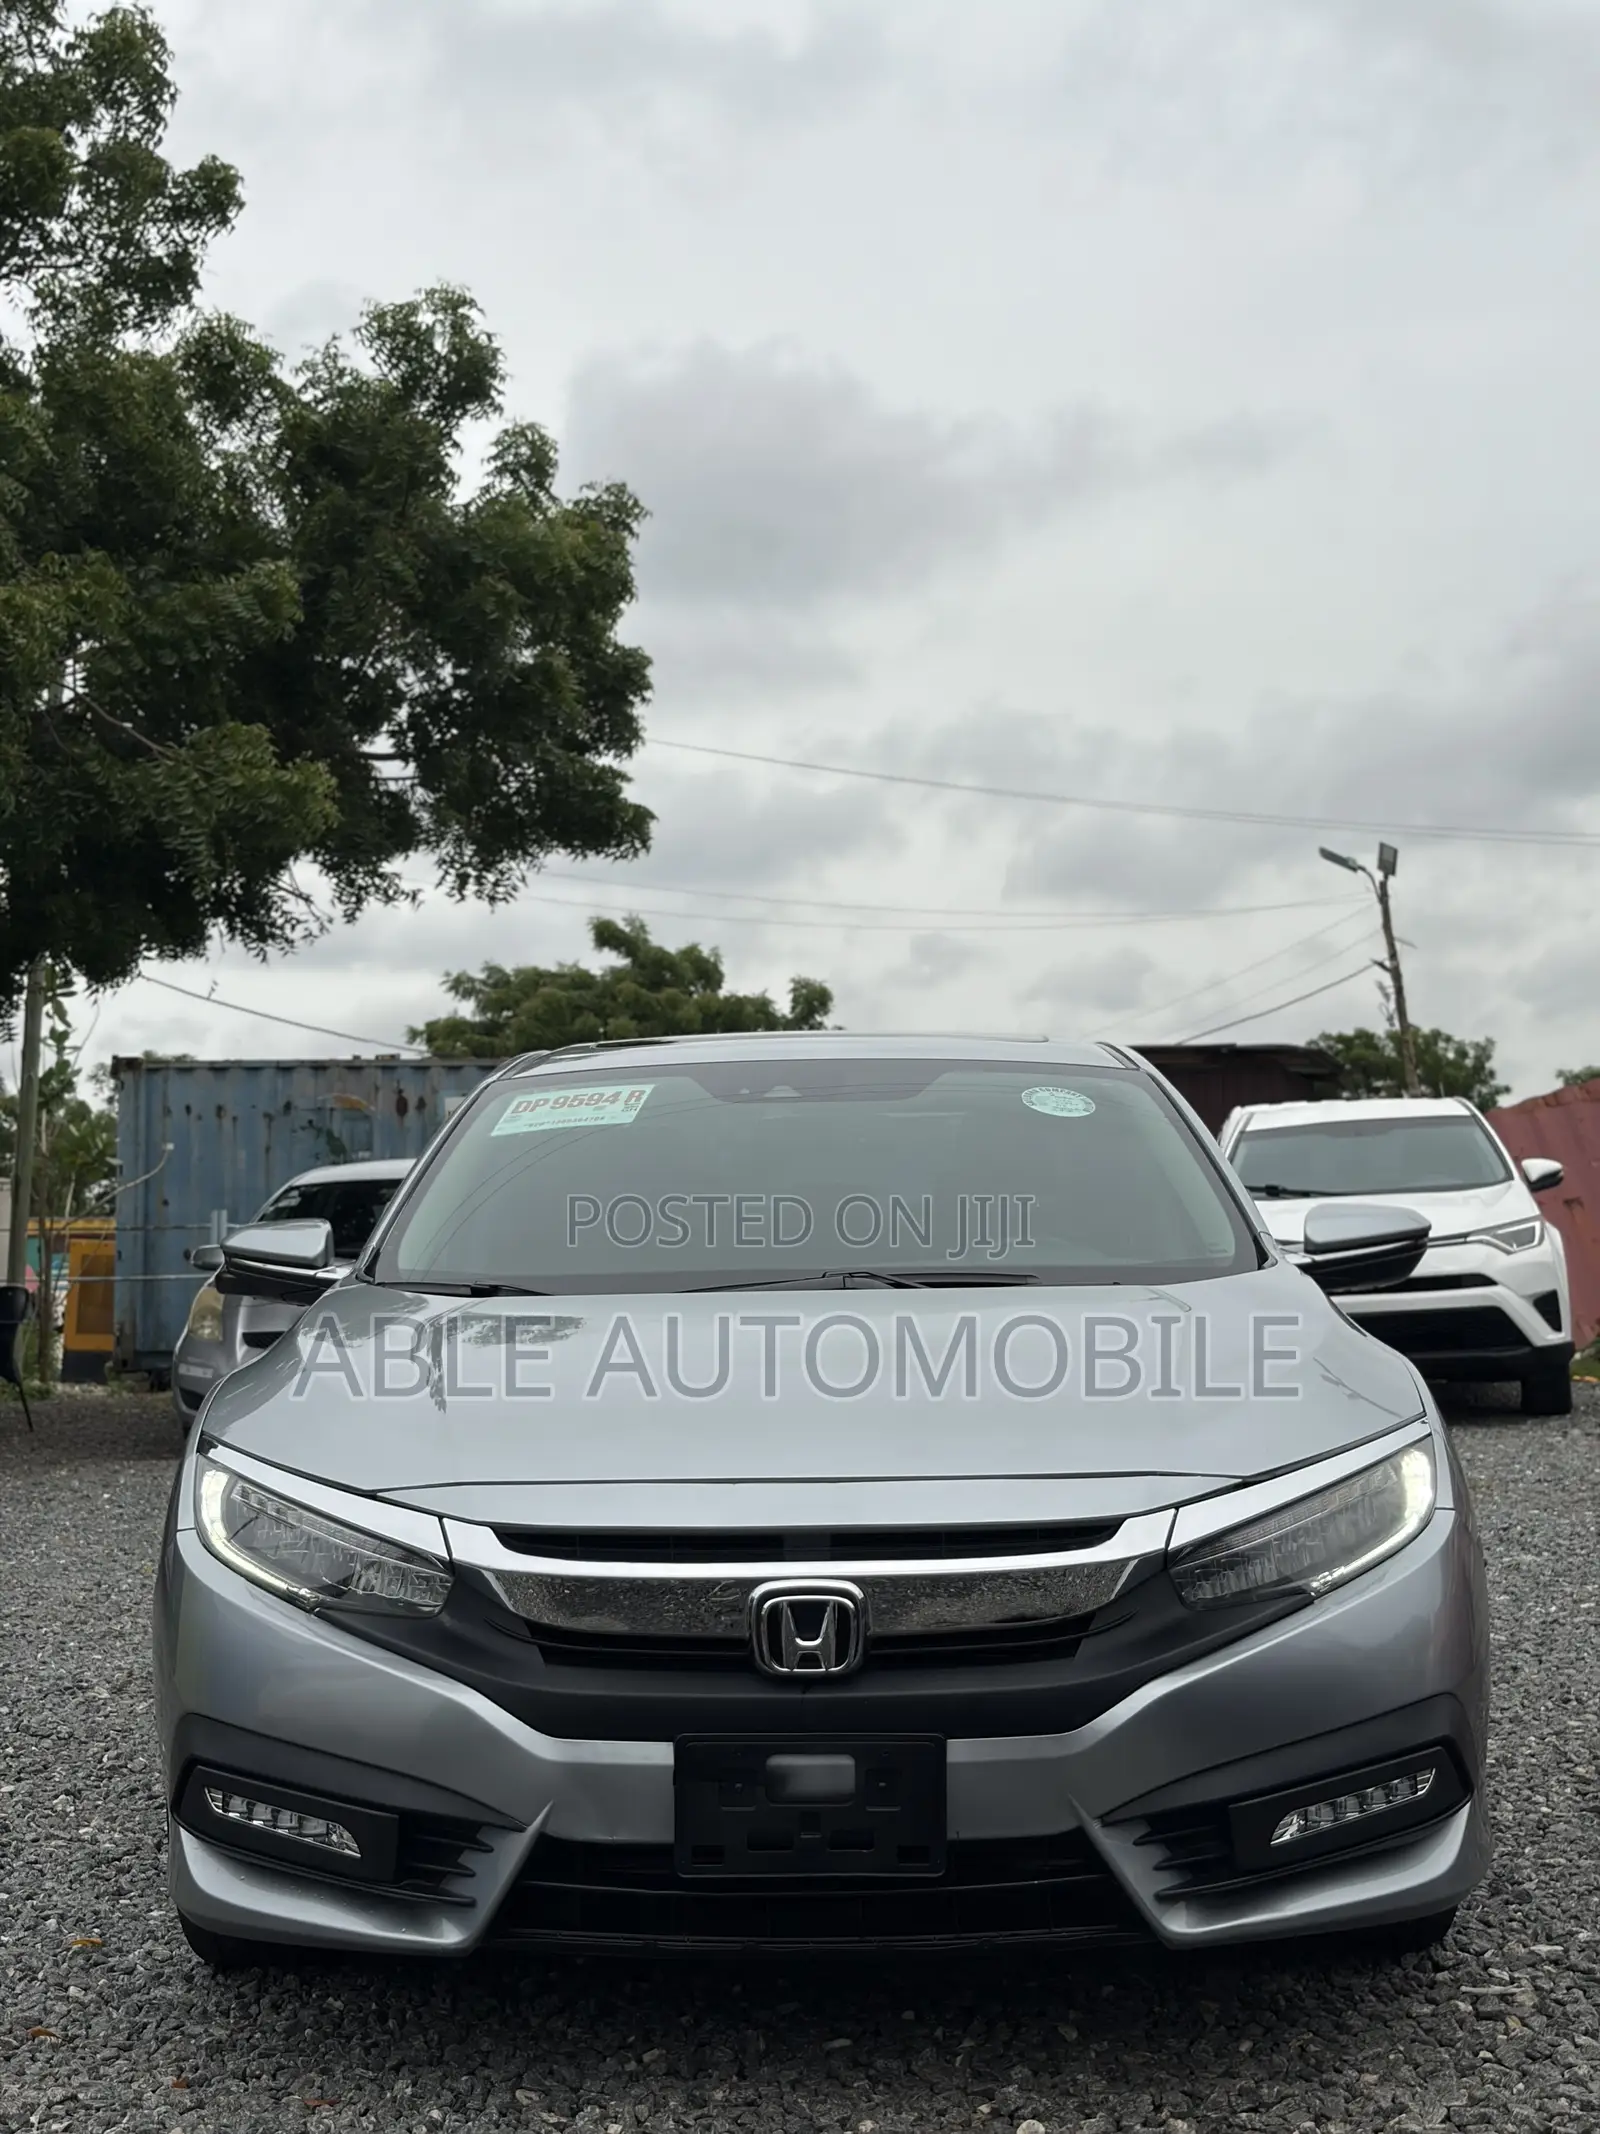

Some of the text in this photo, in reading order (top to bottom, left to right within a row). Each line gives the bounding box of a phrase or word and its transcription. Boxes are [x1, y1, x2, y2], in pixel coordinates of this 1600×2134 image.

[510, 1090, 646, 1114] DP 9594 R
